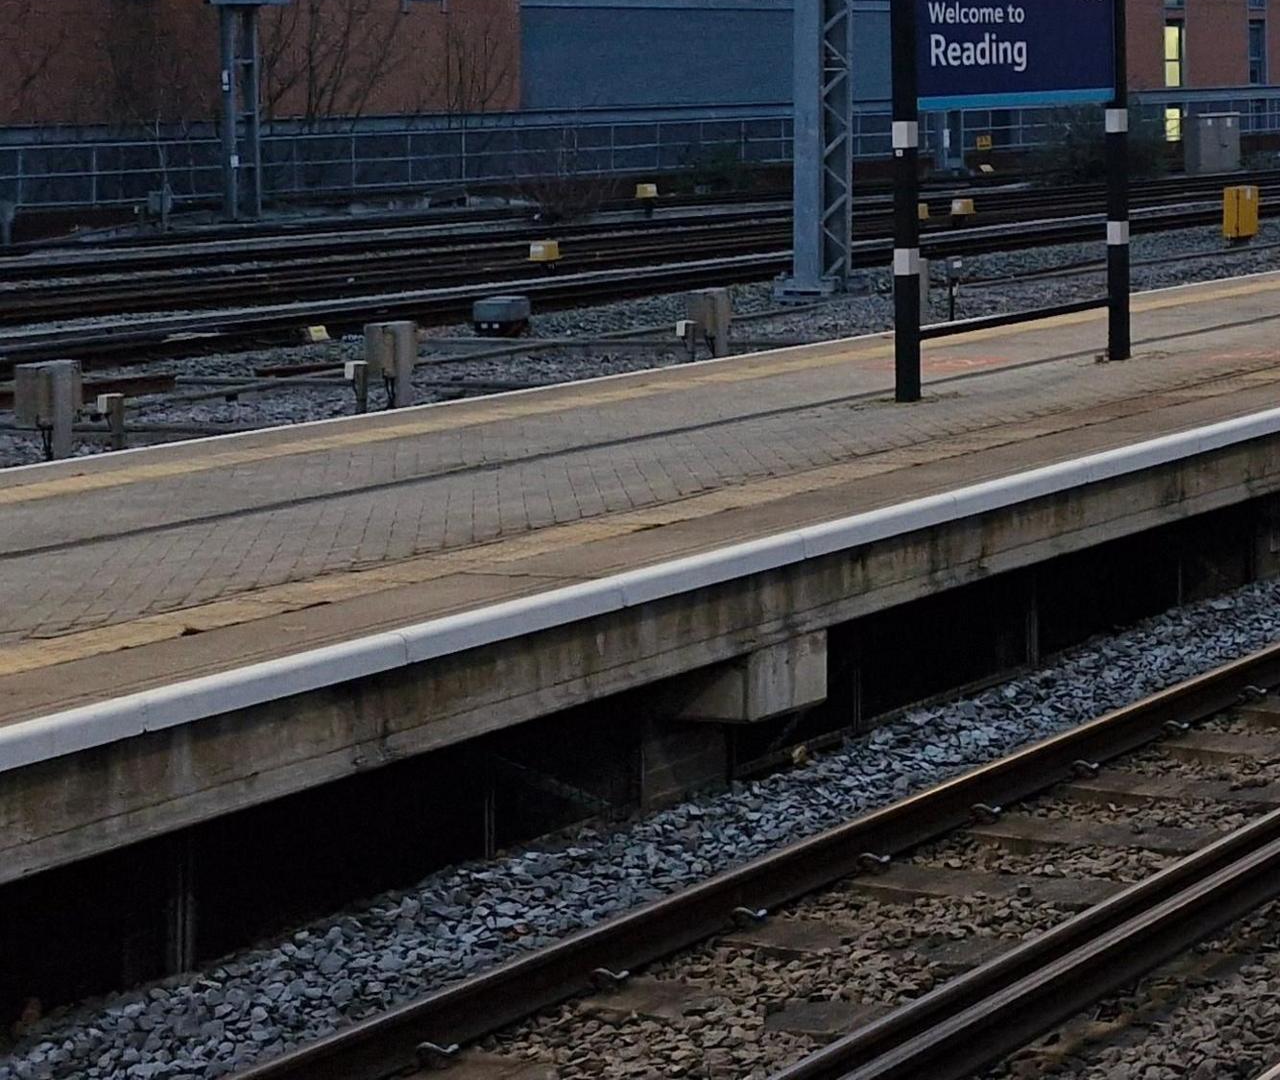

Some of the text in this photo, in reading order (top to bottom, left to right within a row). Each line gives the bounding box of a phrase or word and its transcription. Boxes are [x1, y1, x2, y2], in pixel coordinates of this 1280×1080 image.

[928, 1, 1025, 24] Welcome to
[930, 32, 1027, 72] Reading
